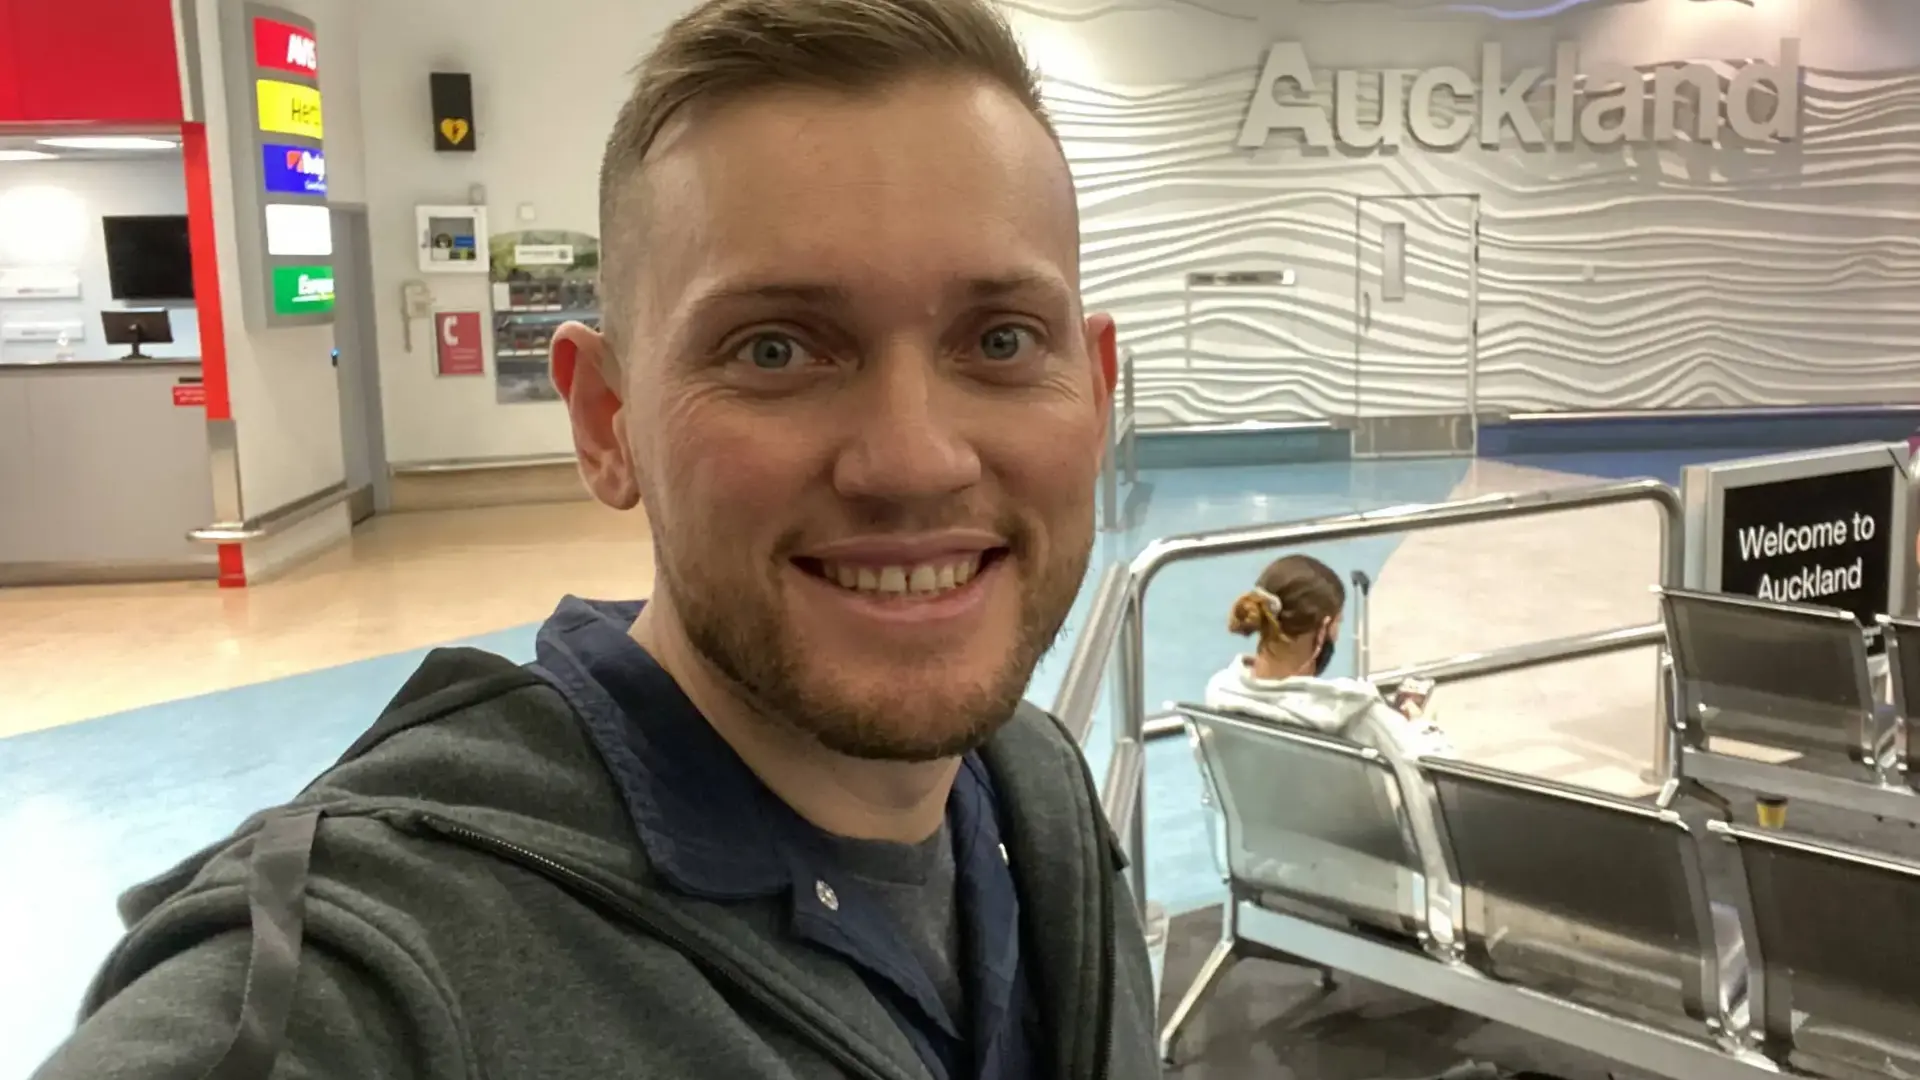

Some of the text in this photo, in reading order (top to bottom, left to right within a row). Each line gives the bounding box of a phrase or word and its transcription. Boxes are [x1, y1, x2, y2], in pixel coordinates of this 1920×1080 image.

[1237, 37, 1801, 151] Auckland
[1738, 512, 1875, 561] Welcome to
[1757, 556, 1863, 603] Auckland
